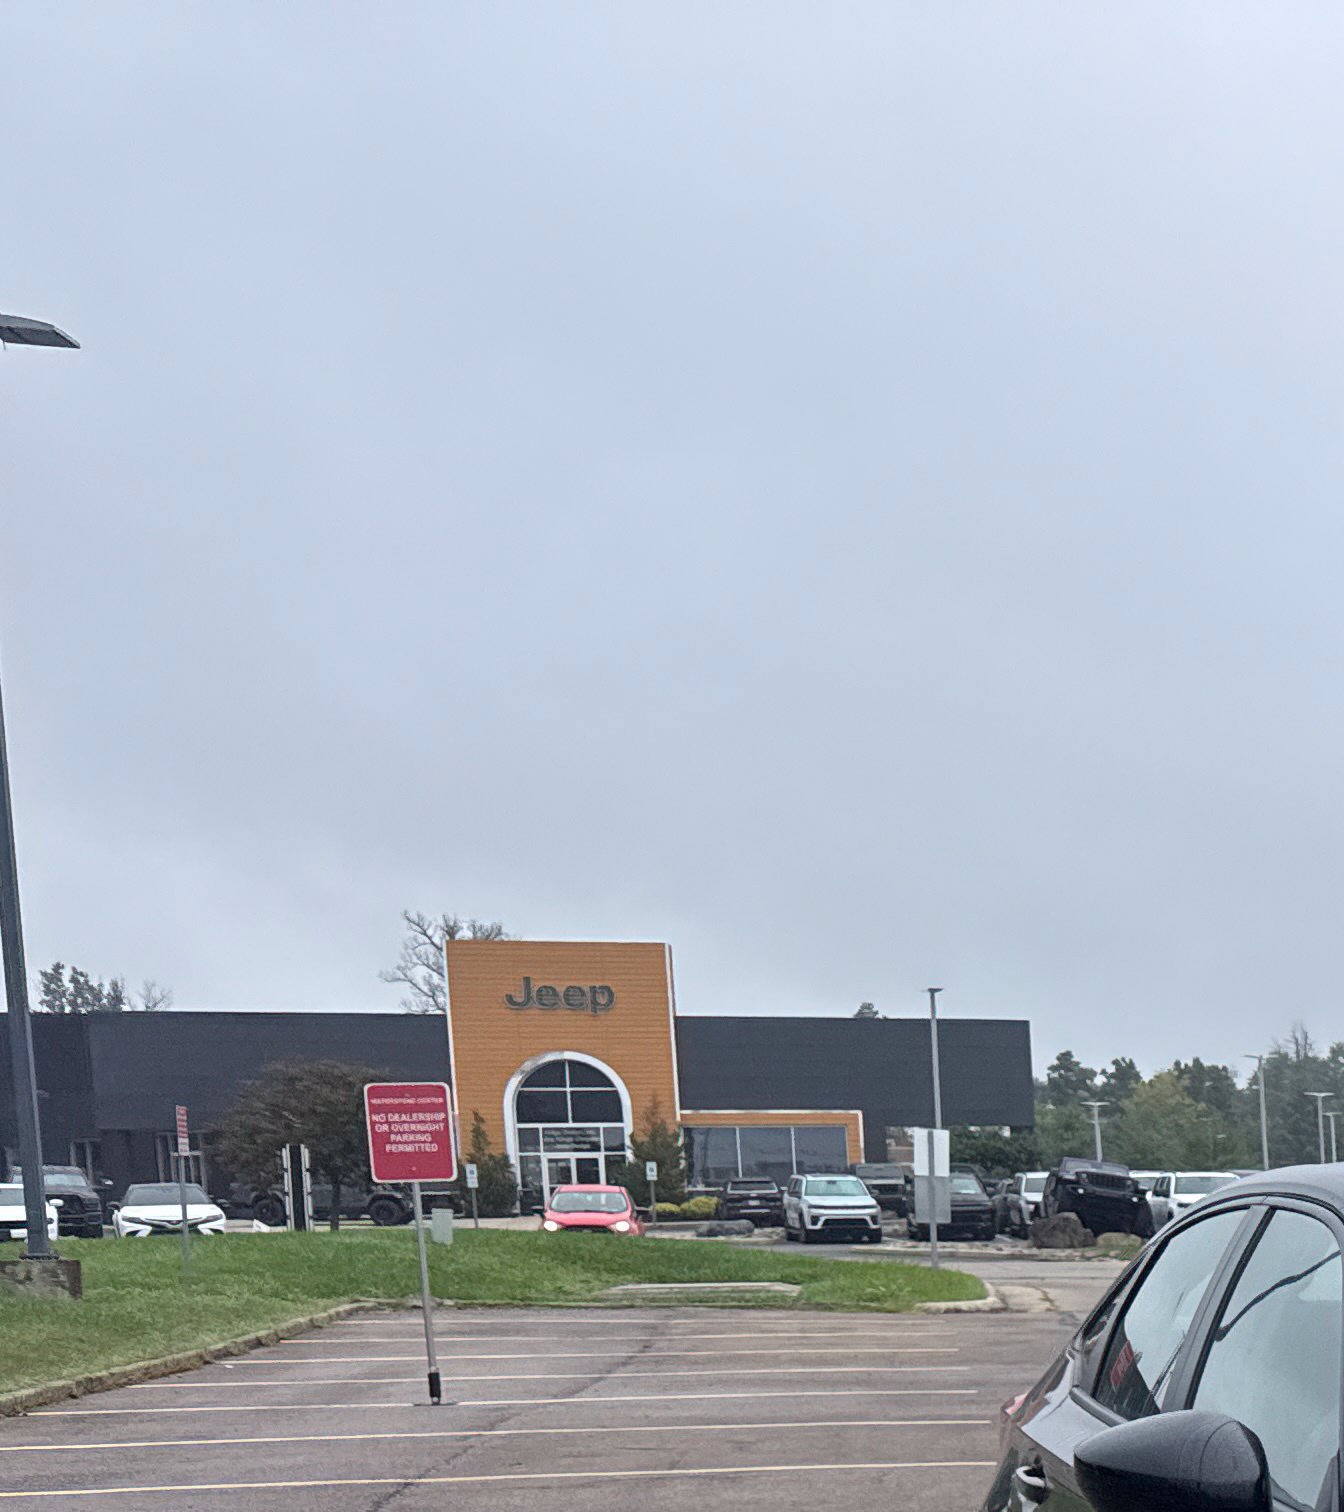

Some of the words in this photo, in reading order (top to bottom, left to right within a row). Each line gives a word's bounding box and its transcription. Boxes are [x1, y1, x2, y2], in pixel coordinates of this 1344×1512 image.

[505, 976, 615, 1014] Jeep
[371, 1113, 386, 1122] NO
[387, 1112, 446, 1122] DEALERSHIP
[374, 1123, 389, 1133] OR
[391, 1122, 445, 1132] OVERNIGHT
[390, 1133, 432, 1142] PARKING
[385, 1143, 438, 1153] PERMITTED
